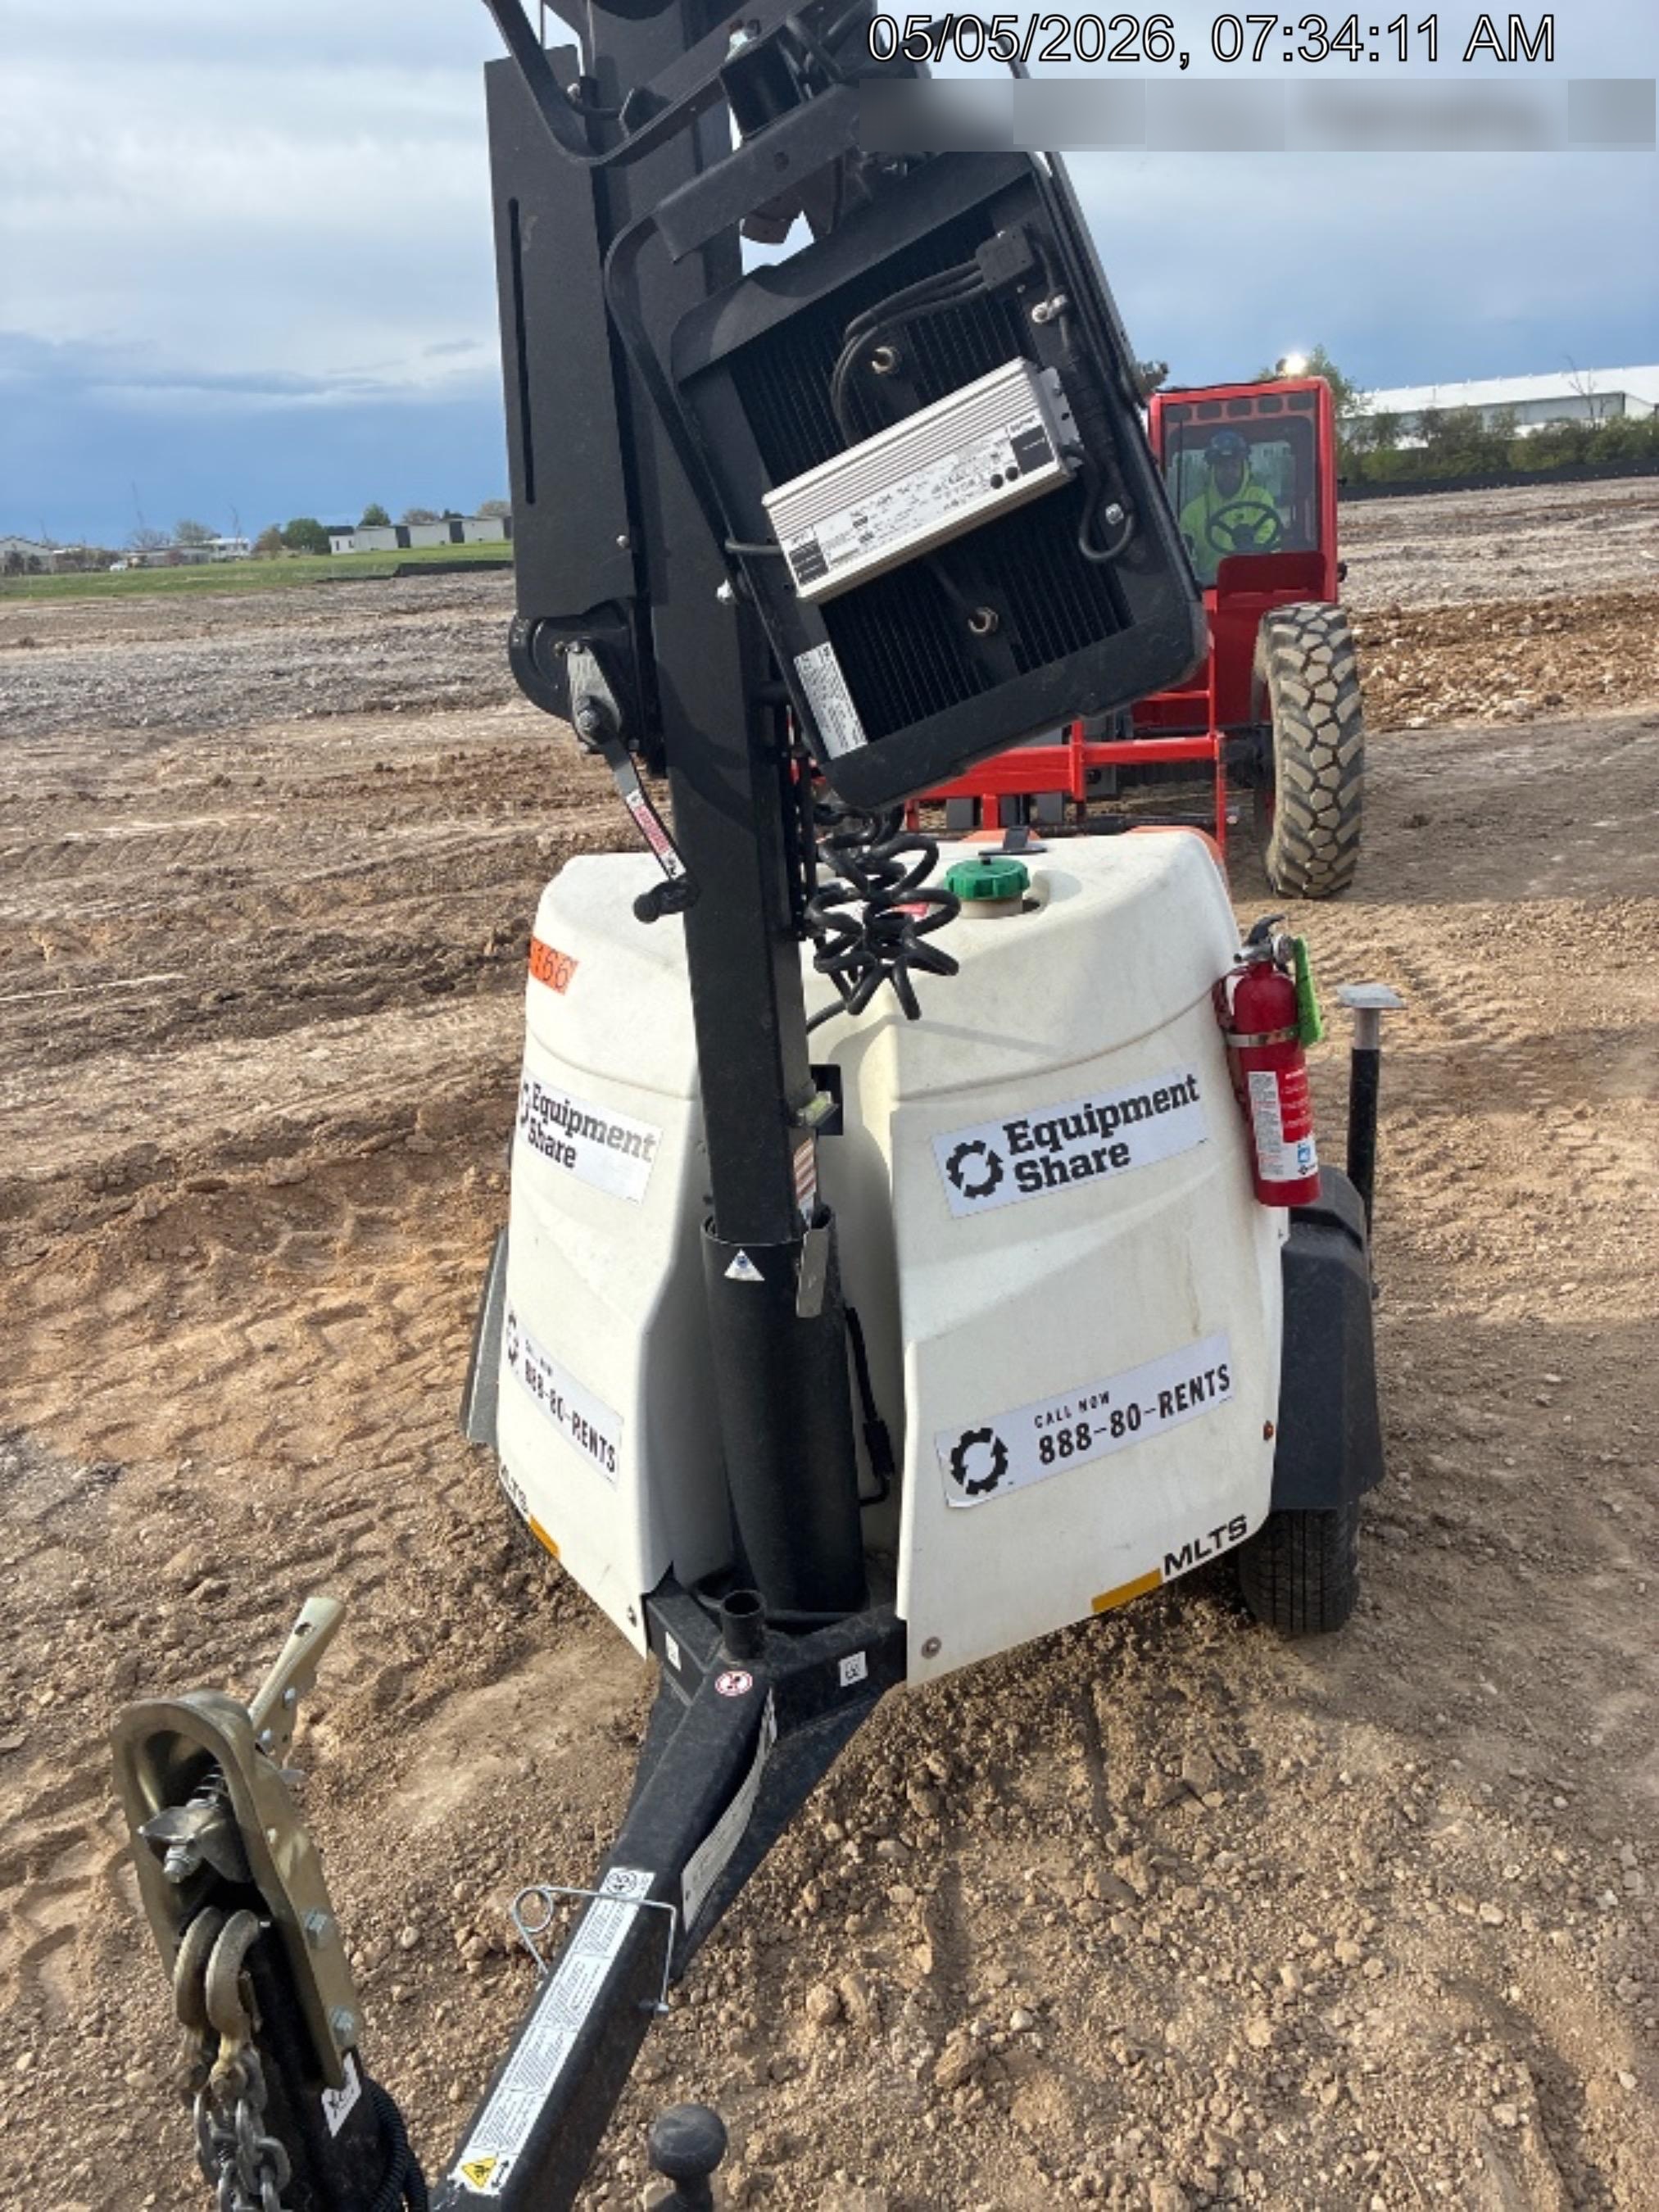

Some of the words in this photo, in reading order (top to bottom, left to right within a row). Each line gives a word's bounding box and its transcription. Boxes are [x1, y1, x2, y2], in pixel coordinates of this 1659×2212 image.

[528, 1117, 578, 1169] Share
[531, 1081, 657, 1164] Equipment
[1002, 1073, 1201, 1156] Equipment
[1013, 1140, 1131, 1194] Share
[1034, 1405, 1072, 1430] CALL
[1077, 1389, 1111, 1413] NOW
[1038, 1363, 1231, 1466] 888-80-RENTS
[1163, 1514, 1248, 1577] MLTS
